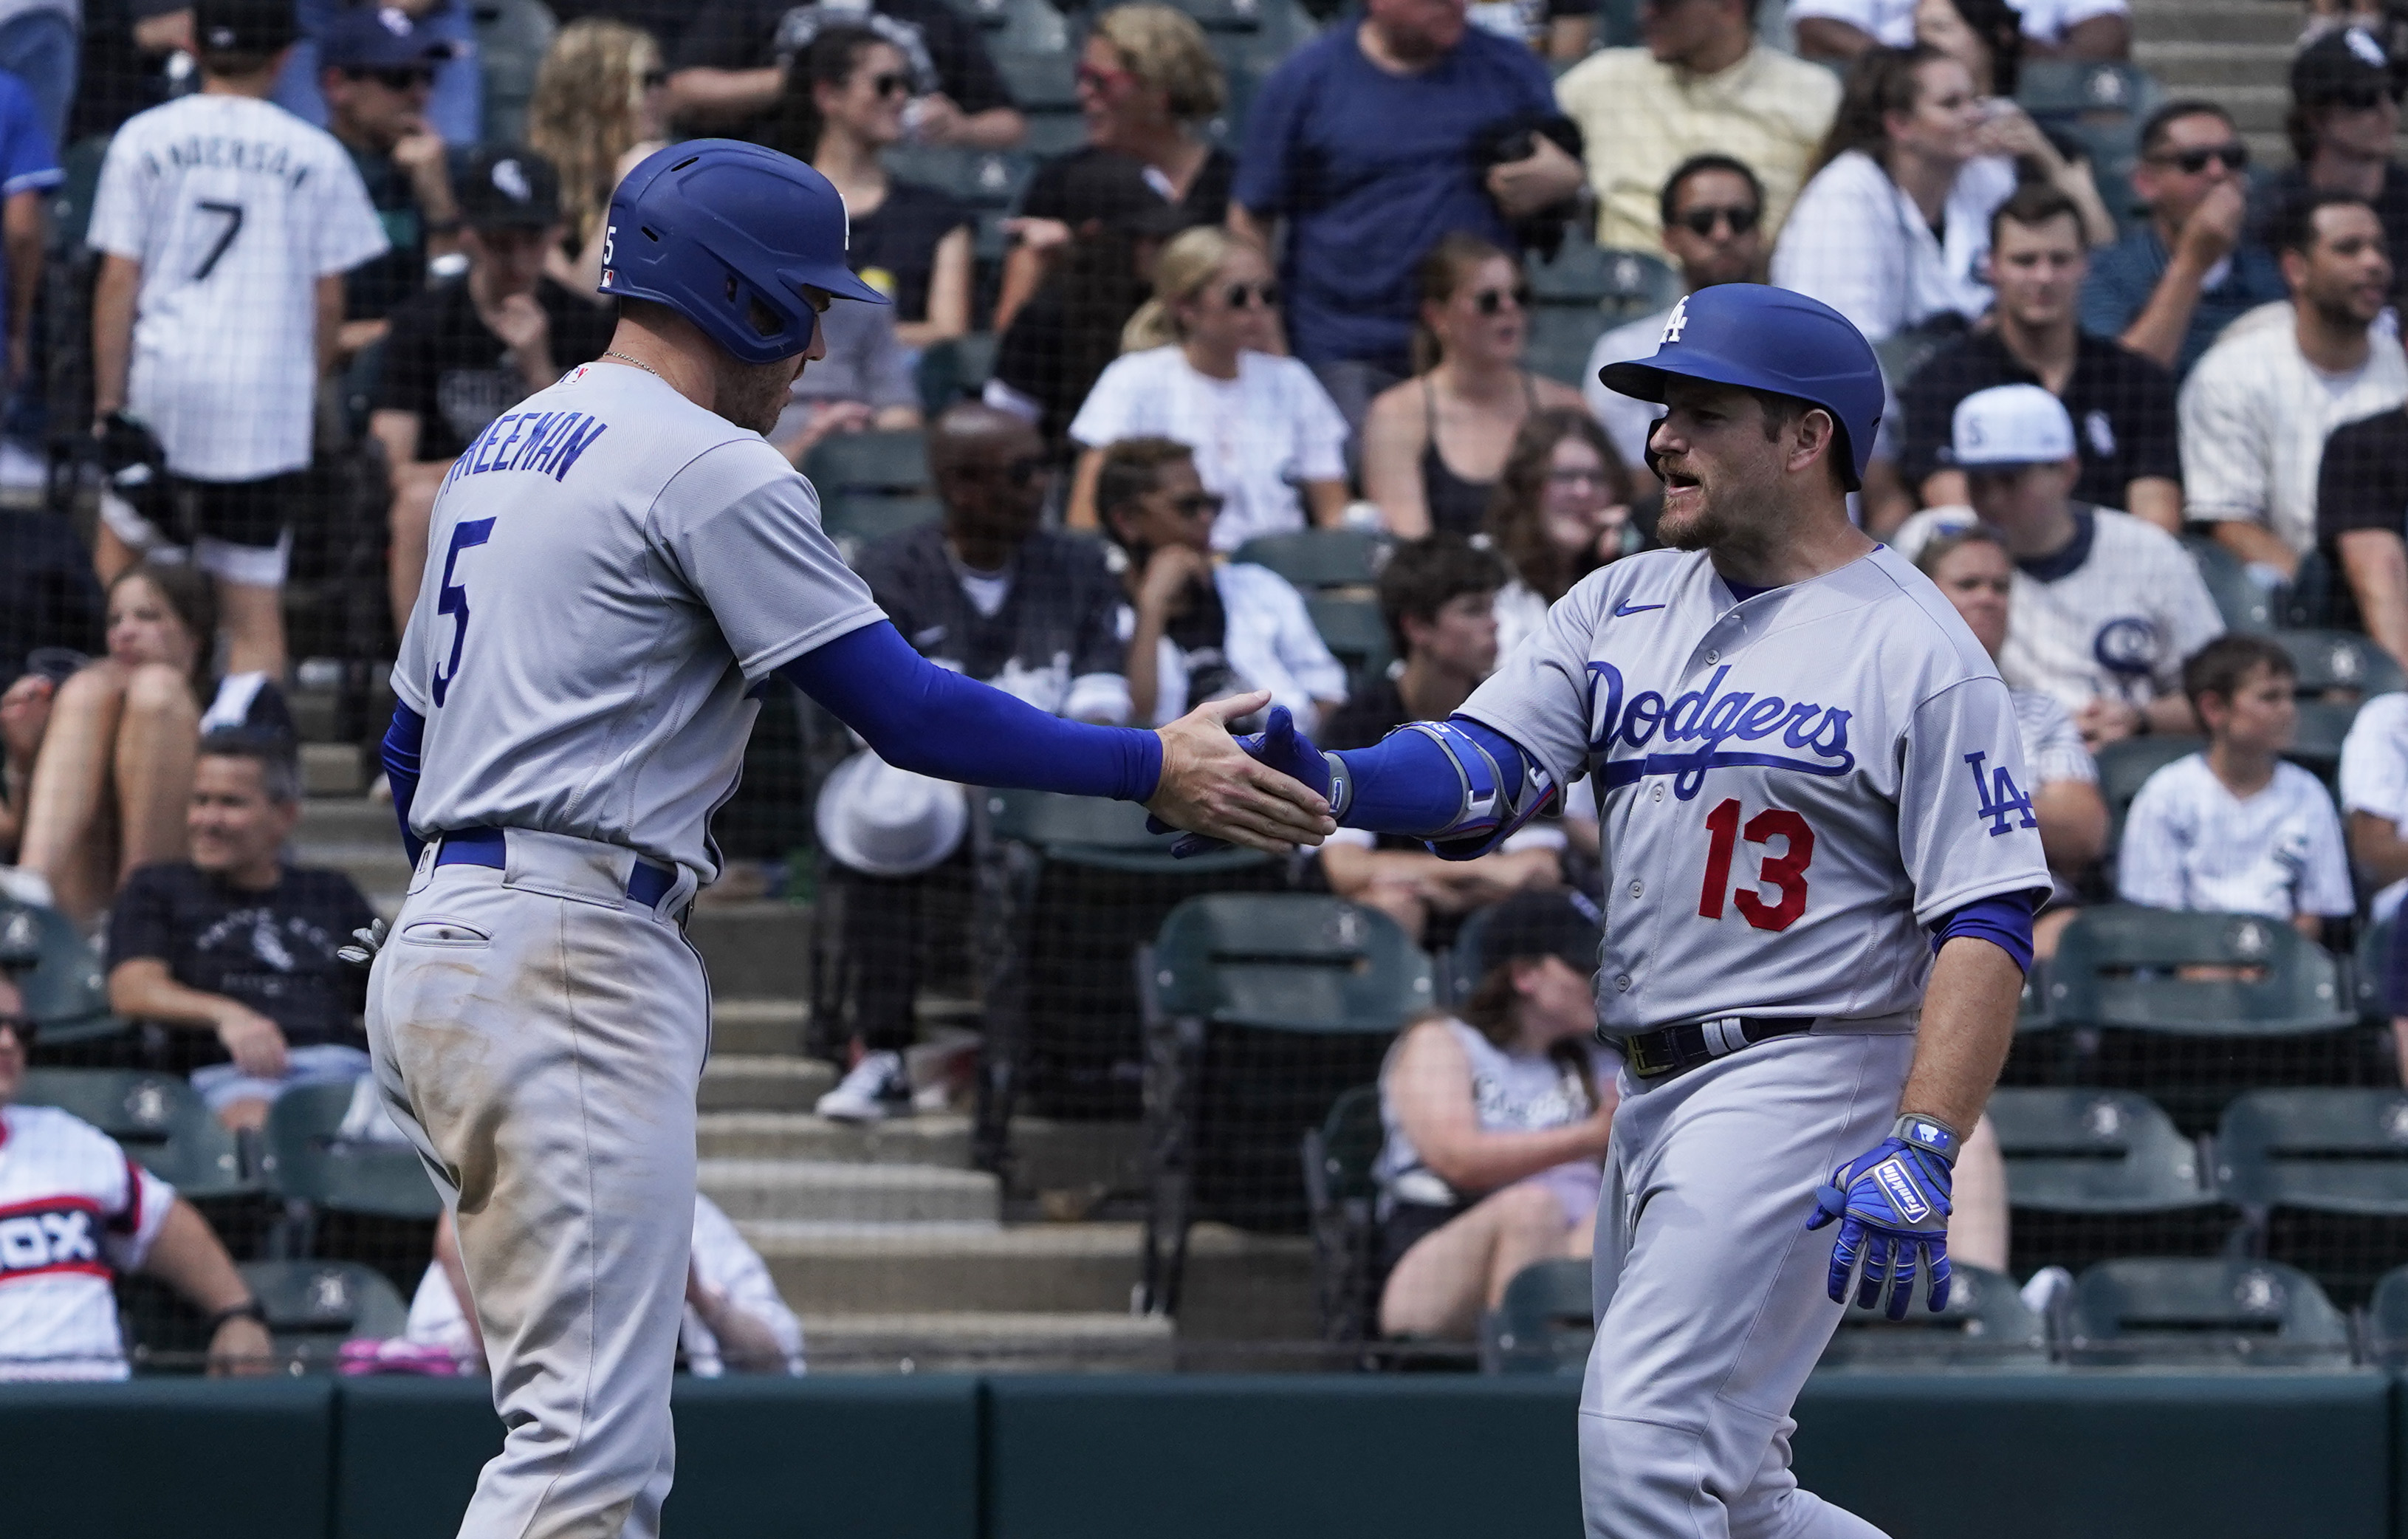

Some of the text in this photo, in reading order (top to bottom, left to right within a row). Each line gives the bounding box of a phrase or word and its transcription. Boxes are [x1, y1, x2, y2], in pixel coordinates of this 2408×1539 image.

[194, 200, 243, 281] 7
[603, 225, 617, 265] 5
[432, 516, 498, 708] 5
[1588, 661, 1856, 801] Dodgers
[1964, 750, 2038, 837] LA
[1698, 798, 1816, 932] 13
